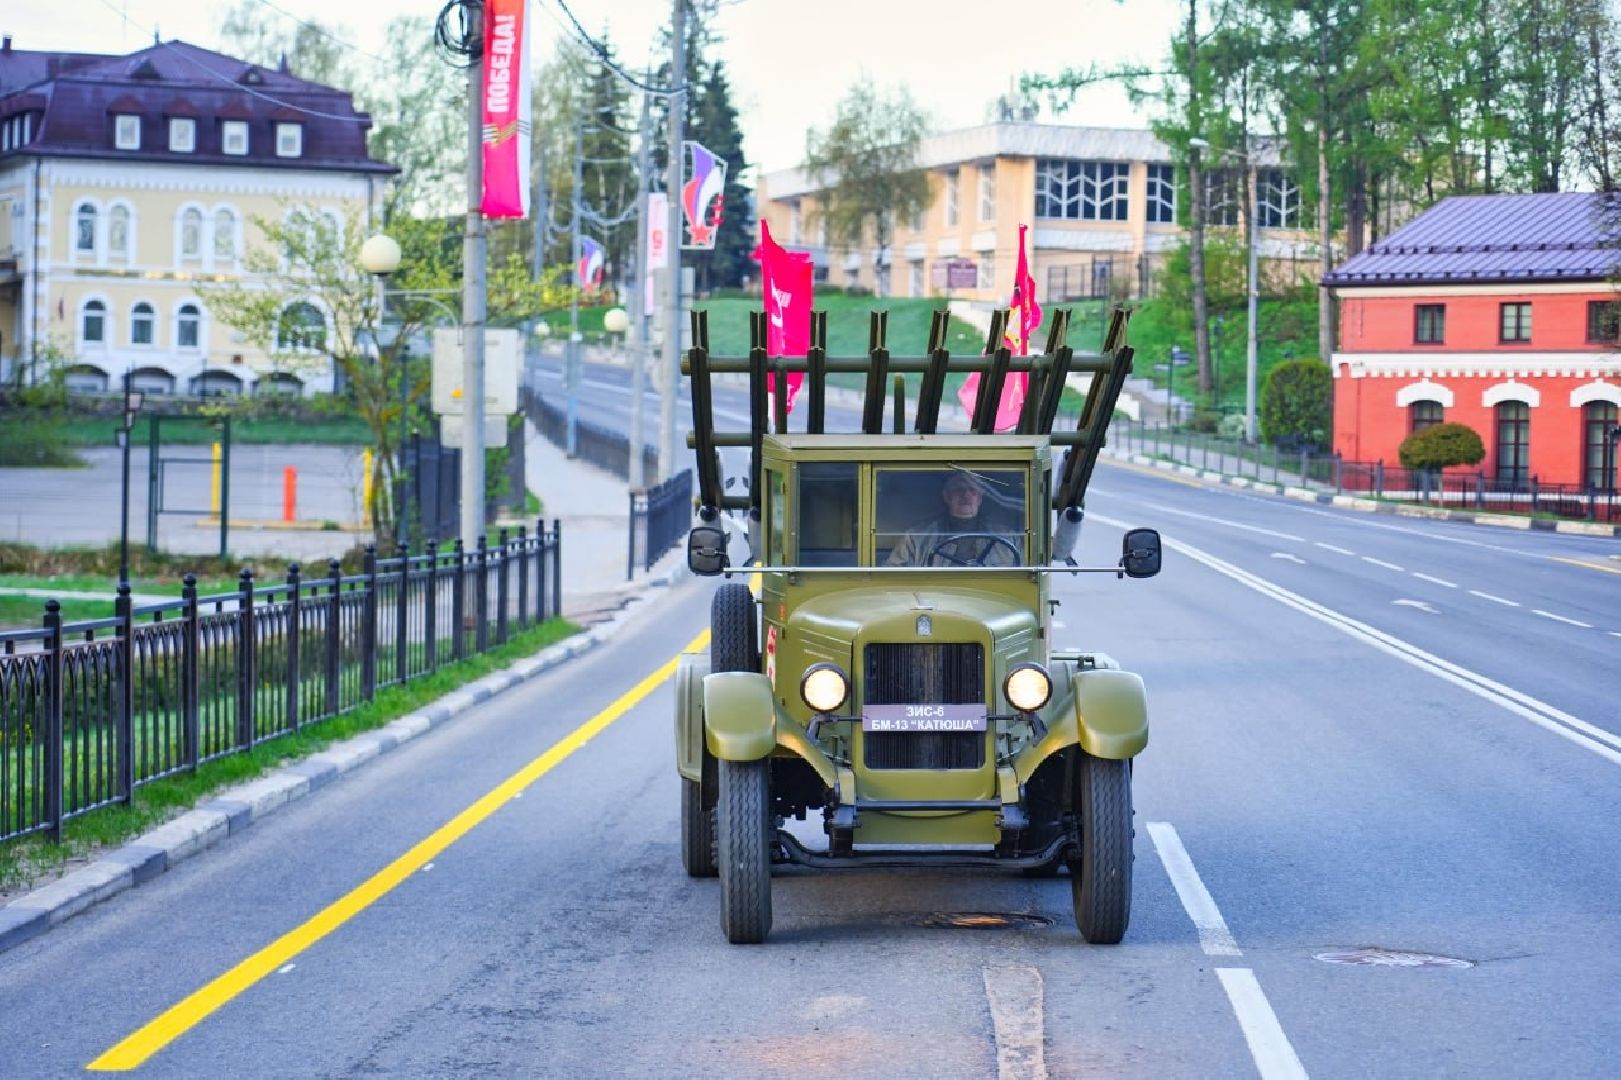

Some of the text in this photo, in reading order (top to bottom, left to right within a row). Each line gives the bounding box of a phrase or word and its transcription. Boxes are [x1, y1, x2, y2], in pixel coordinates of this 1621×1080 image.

[487, 15, 516, 113] ПОБЕДА!
[906, 707, 944, 717] ЗИС-6
[872, 719, 908, 730] БМ-13
